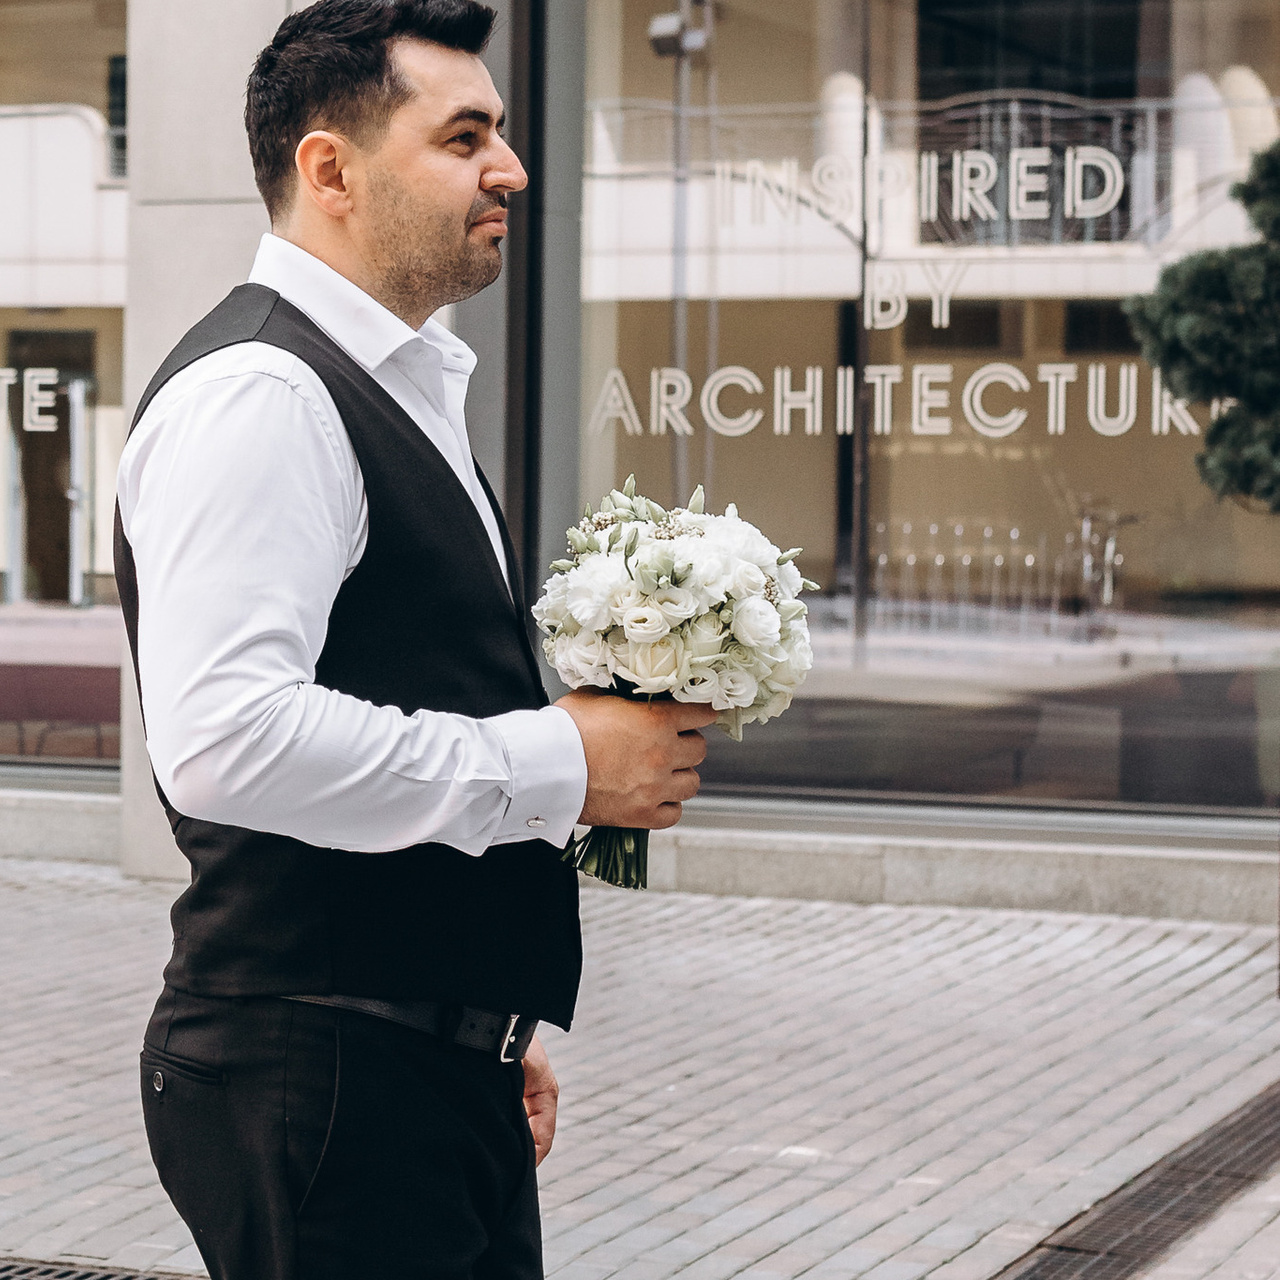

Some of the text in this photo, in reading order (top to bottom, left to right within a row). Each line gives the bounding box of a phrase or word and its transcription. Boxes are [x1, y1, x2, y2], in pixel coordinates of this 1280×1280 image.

[714, 145, 1124, 226] INSPIRED
[863, 258, 970, 331] BY
[587, 362, 1238, 438] ARCHITECTUR
